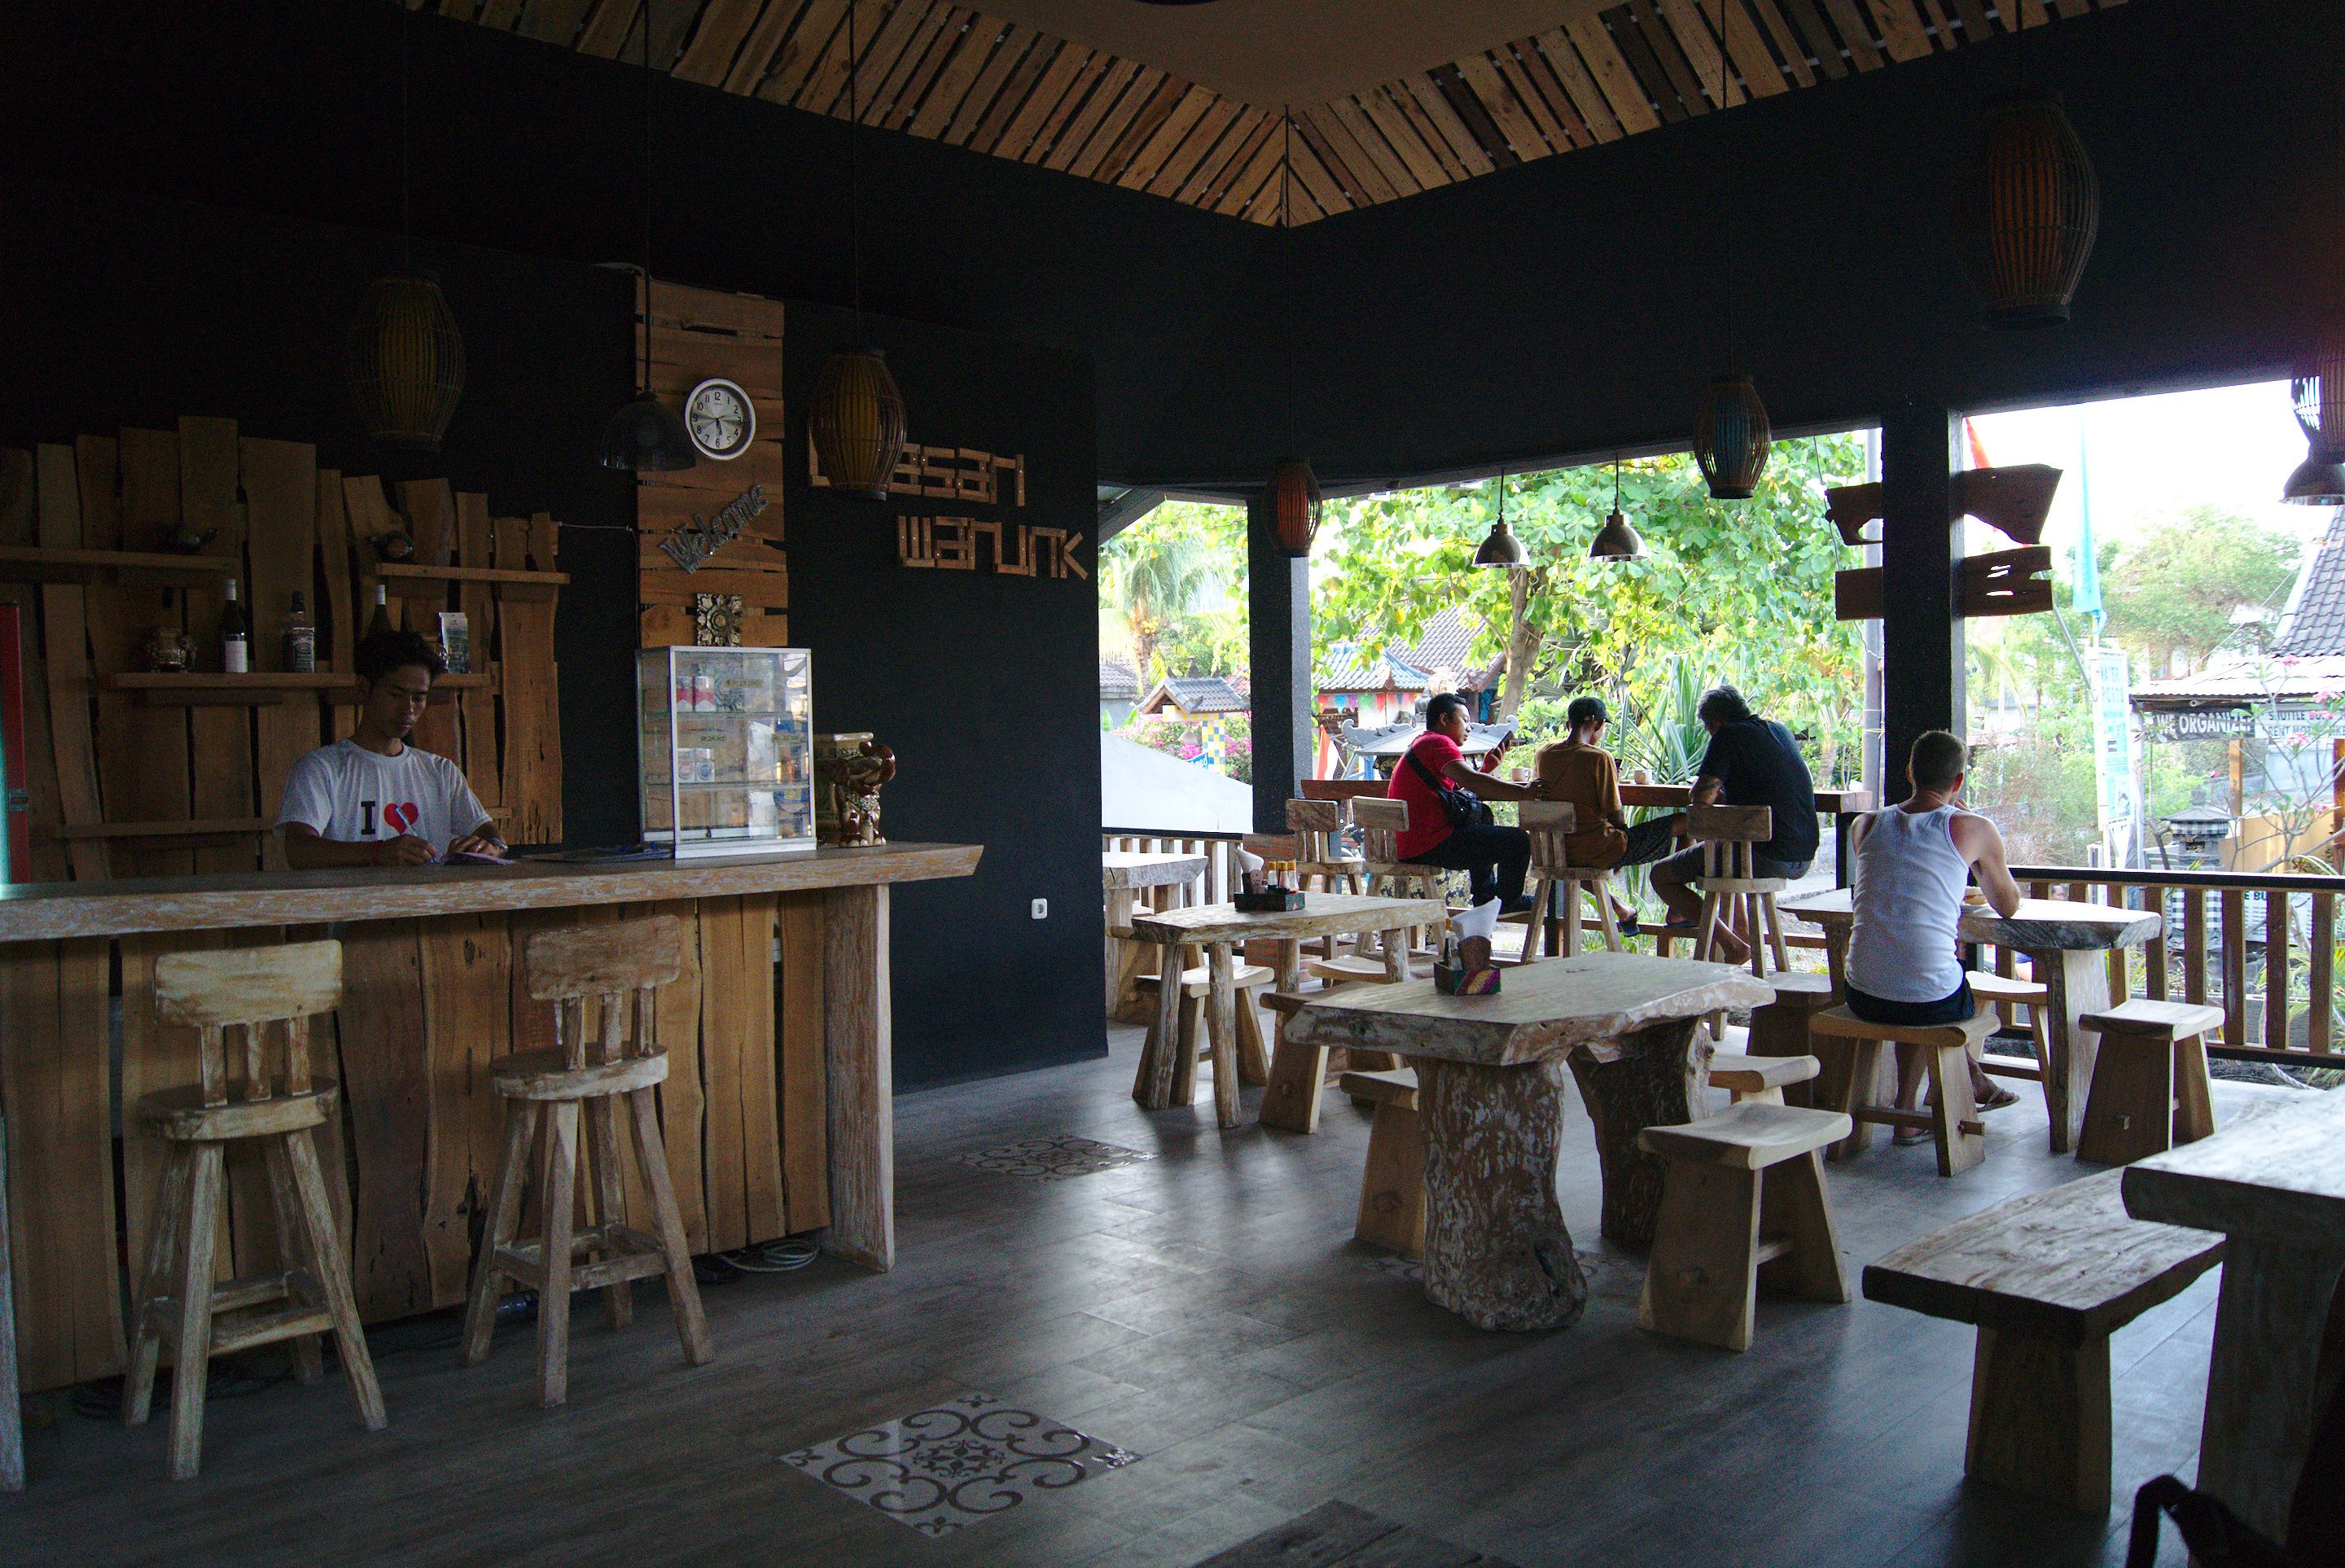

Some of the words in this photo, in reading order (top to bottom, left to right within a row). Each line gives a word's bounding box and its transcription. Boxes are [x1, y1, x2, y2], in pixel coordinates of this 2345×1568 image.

[705, 394, 710, 403] 11
[714, 392, 721, 401] 12
[696, 401, 704, 411] 10
[734, 405, 739, 414] 2
[697, 425, 702, 434] 8
[734, 428, 739, 436] 4
[705, 434, 710, 443] 7
[726, 436, 731, 445] 5
[657, 483, 769, 574] Welcome
[2156, 713, 2176, 734] WE
[361, 801, 375, 834] I
